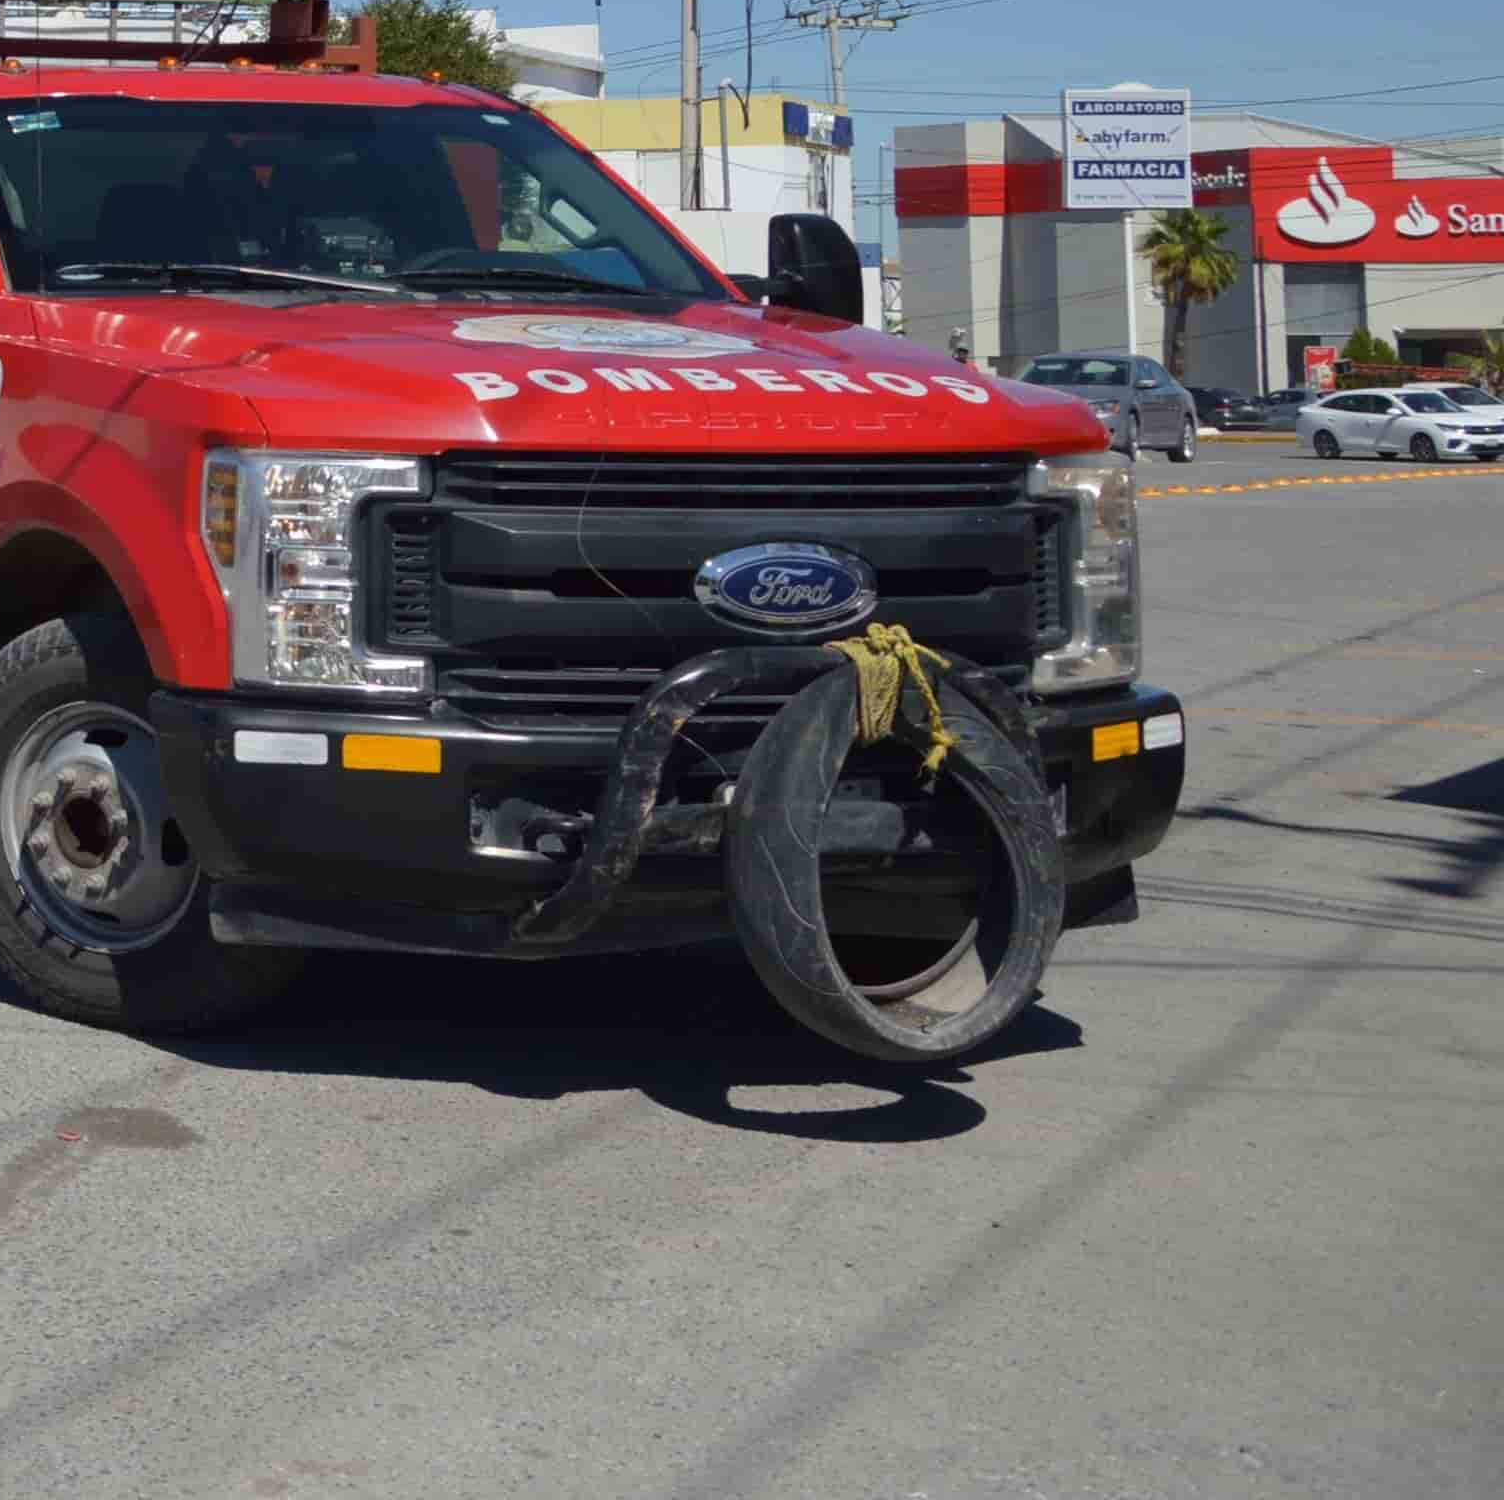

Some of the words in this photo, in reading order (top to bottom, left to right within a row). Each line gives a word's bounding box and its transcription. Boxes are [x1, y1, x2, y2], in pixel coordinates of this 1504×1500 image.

[1074, 103, 1182, 114] LABORATORIO
[1076, 163, 1181, 177] FARMACIA
[451, 367, 990, 404] BOMBEROS
[749, 566, 835, 606] Ford
